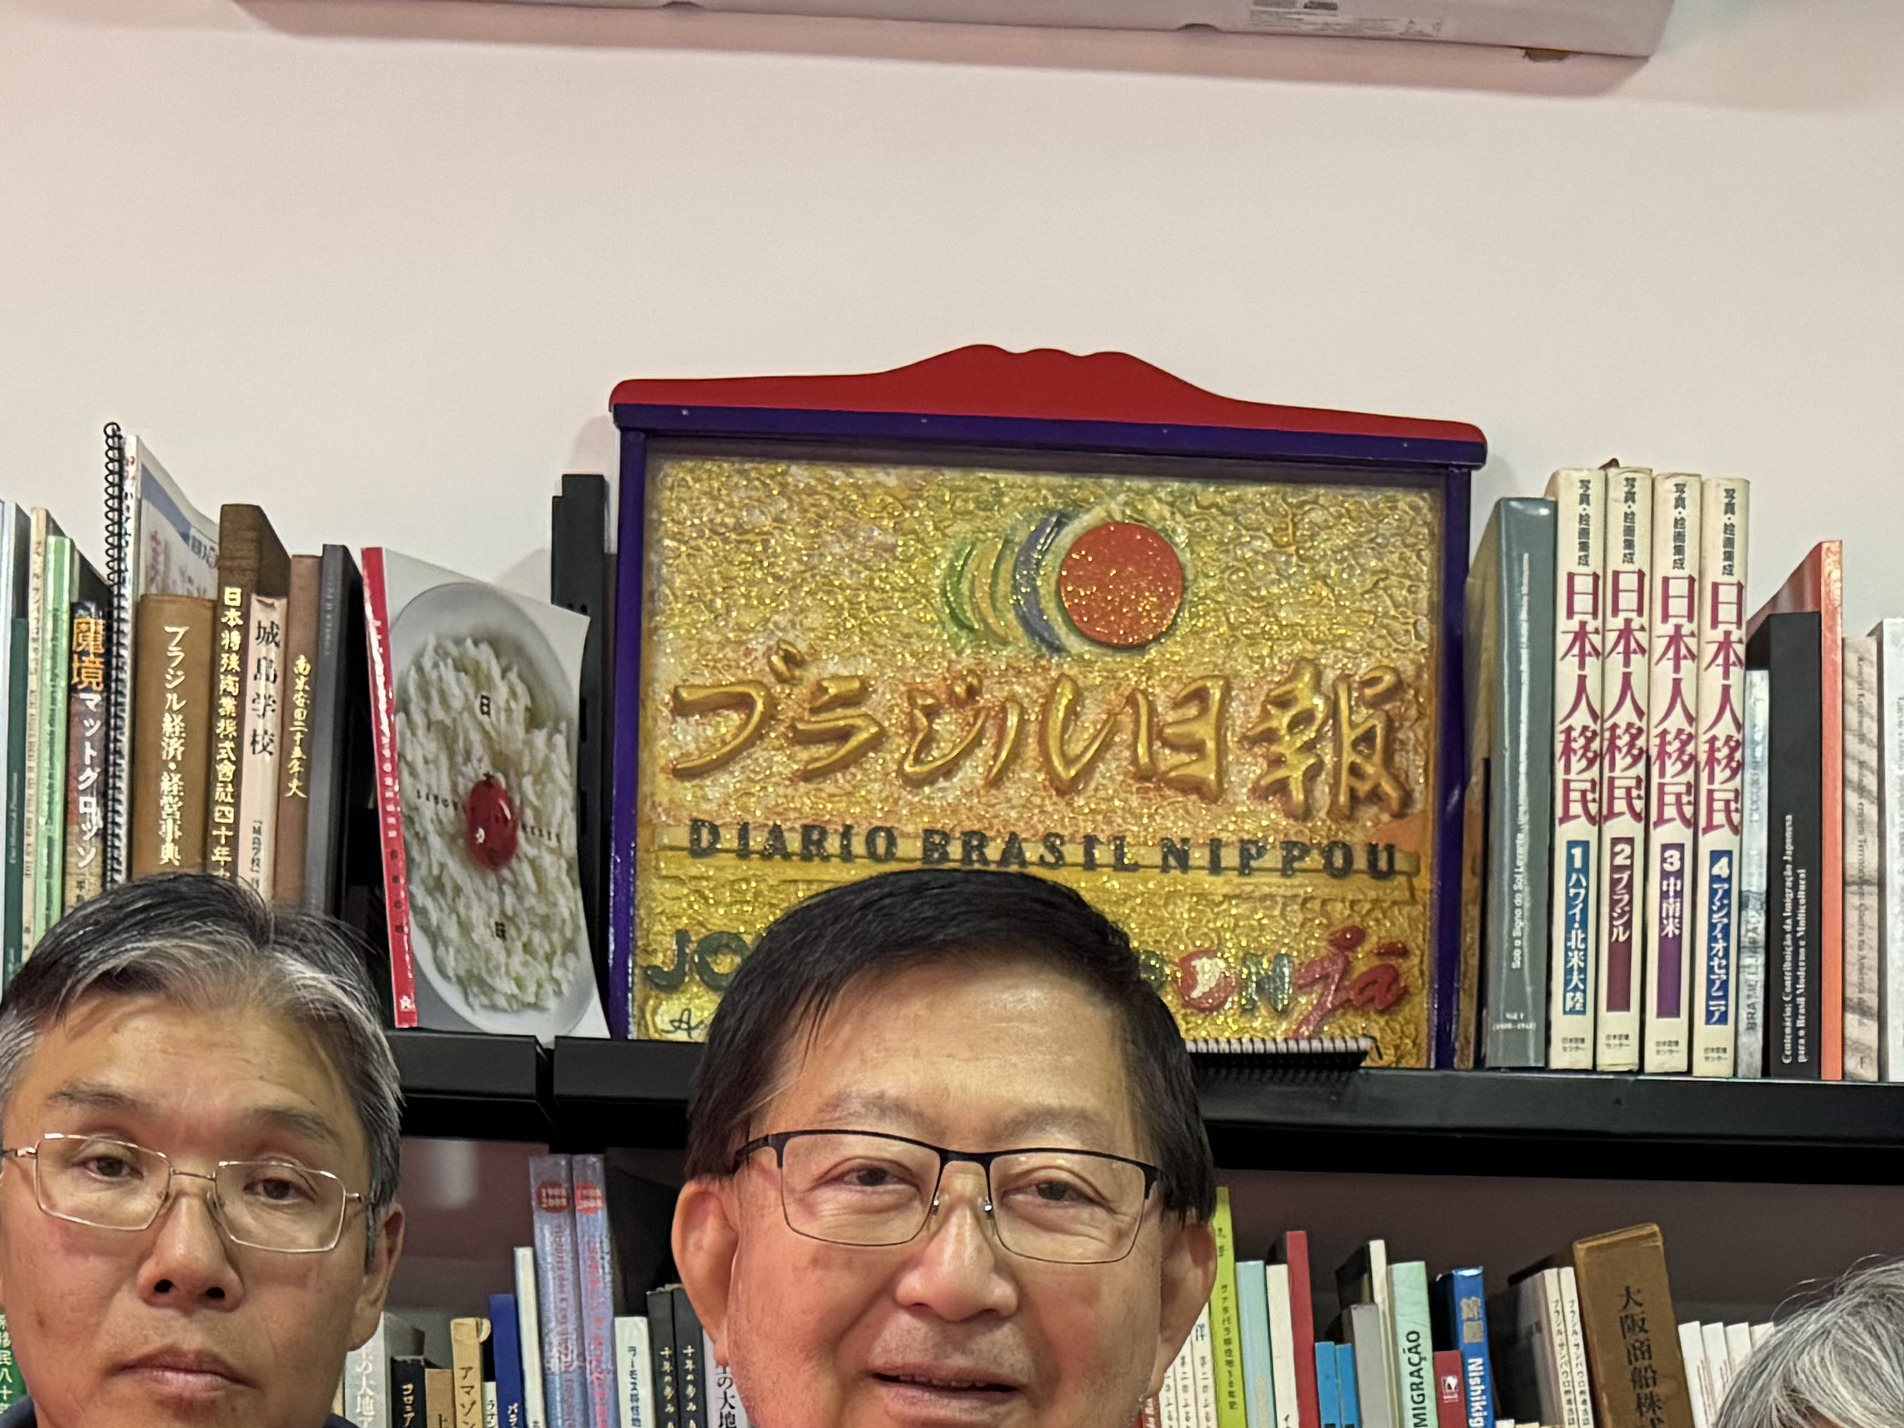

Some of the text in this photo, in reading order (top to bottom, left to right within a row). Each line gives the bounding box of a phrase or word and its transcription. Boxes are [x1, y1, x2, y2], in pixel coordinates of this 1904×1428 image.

[159, 625, 190, 866] ブラジル経済・経営事典
[669, 641, 1414, 826] ブラジル日報
[1558, 571, 1602, 828] 日本人移民
[1603, 568, 1647, 825] 日本人移民
[1652, 574, 1697, 831] 日本人移民
[1700, 580, 1745, 836] 日本人移民
[689, 817, 1395, 881] DIARIO BRASIL NIPPOU
[1571, 847, 1583, 869] 1
[1611, 872, 1631, 943] ブラジル
[1613, 843, 1631, 866] 2
[1661, 876, 1682, 938] 中南米
[1663, 850, 1681, 872] 3
[1711, 857, 1730, 878] 4
[1565, 873, 1588, 1012] ハワイ・北米大陸
[1709, 884, 1730, 1024] アジア・オセアニア
